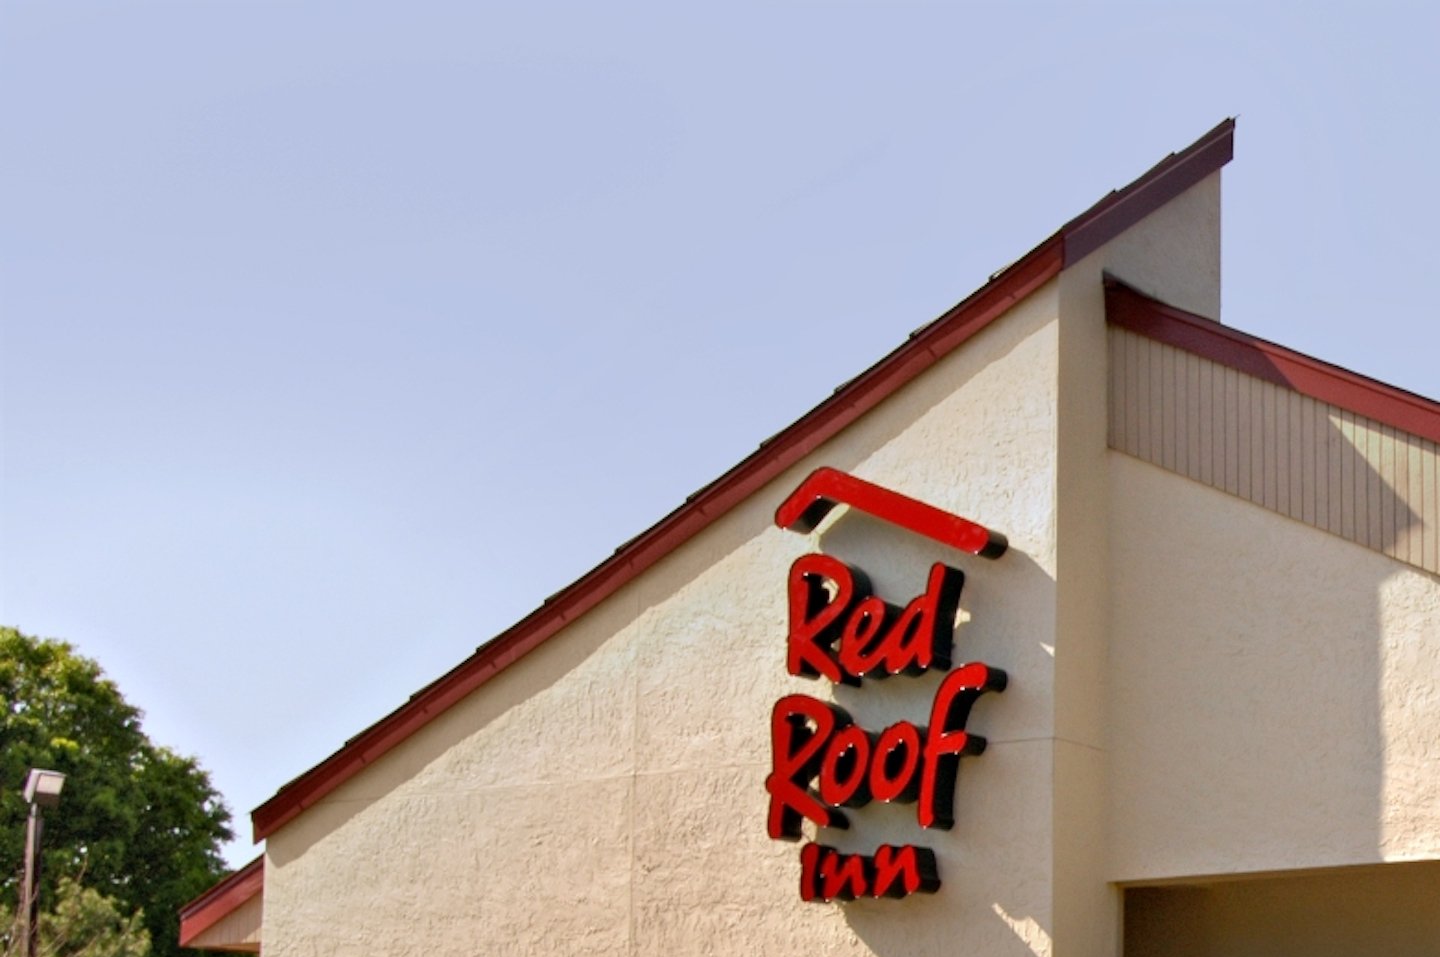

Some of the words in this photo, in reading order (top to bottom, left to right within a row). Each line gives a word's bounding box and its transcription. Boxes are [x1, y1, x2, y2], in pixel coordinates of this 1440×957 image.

[787, 553, 950, 684] Red
[765, 661, 992, 840] Roof
[800, 842, 926, 902] Inn
